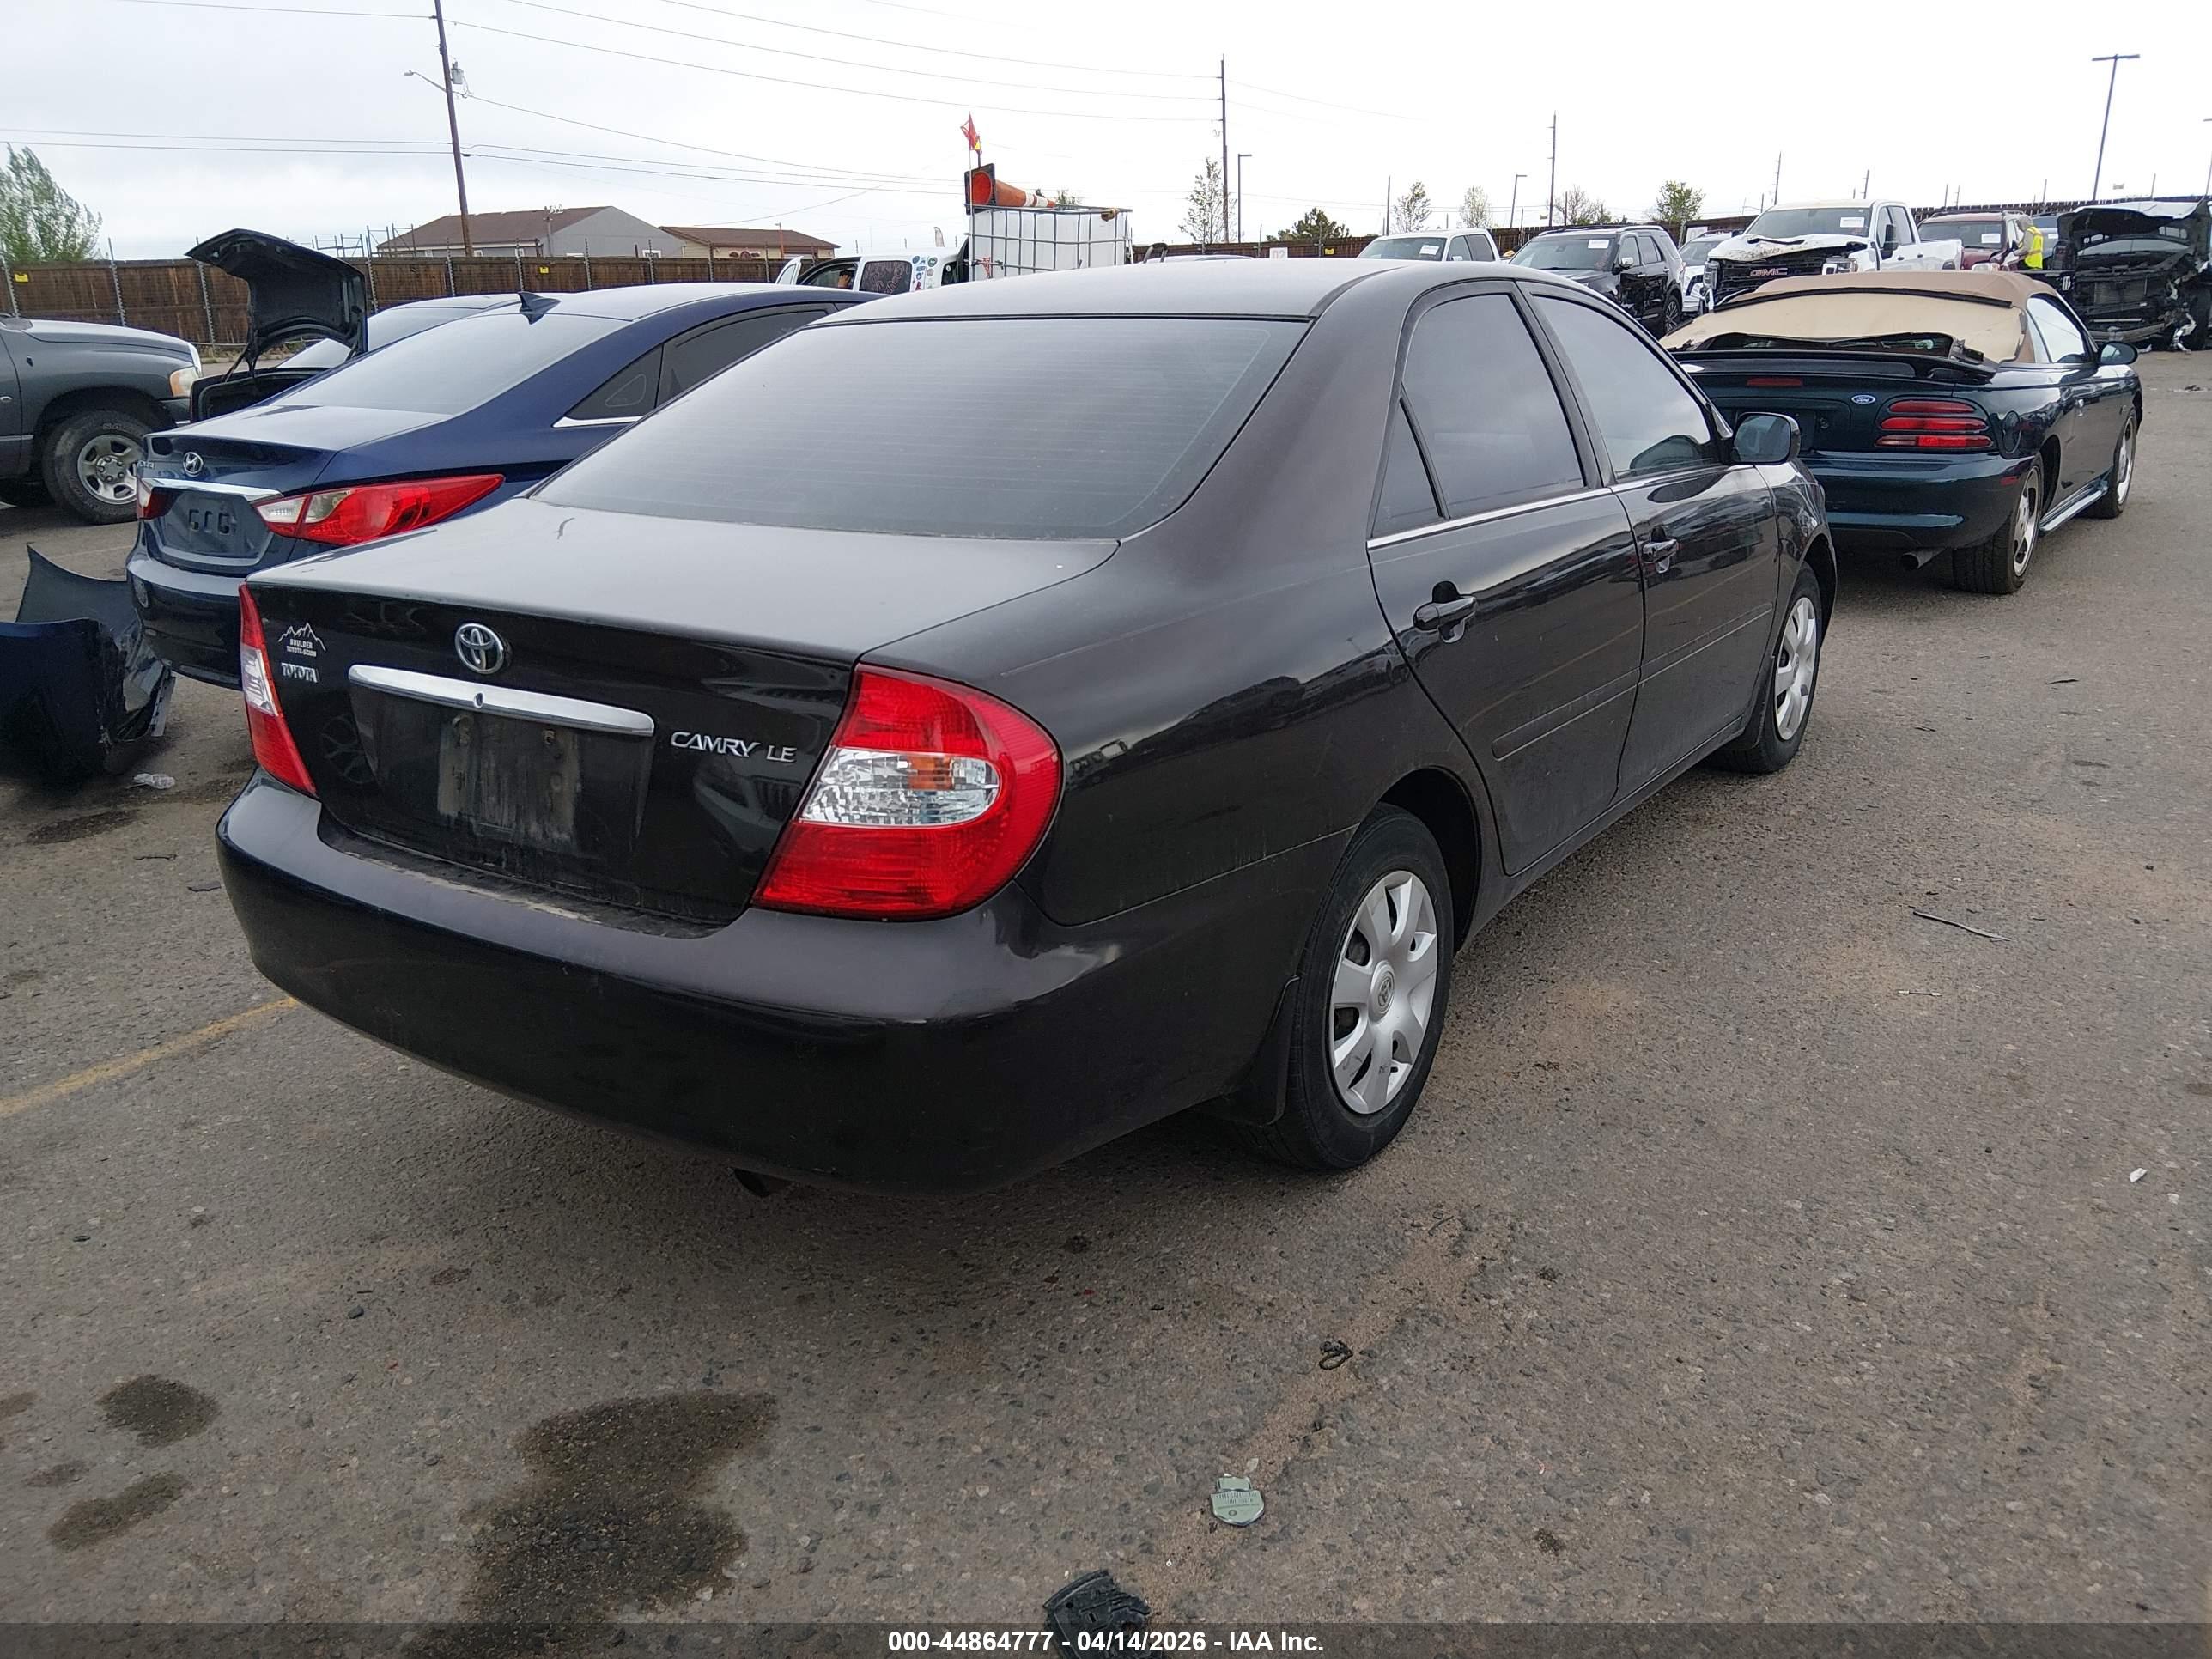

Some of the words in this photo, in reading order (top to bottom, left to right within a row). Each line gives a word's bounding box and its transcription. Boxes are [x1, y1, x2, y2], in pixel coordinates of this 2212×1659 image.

[1750, 267, 1788, 276] GMC
[289, 638, 313, 649] BOULDER
[281, 662, 318, 683] TOYOTA
[671, 732, 761, 757] CAMRY
[766, 745, 797, 763] LE
